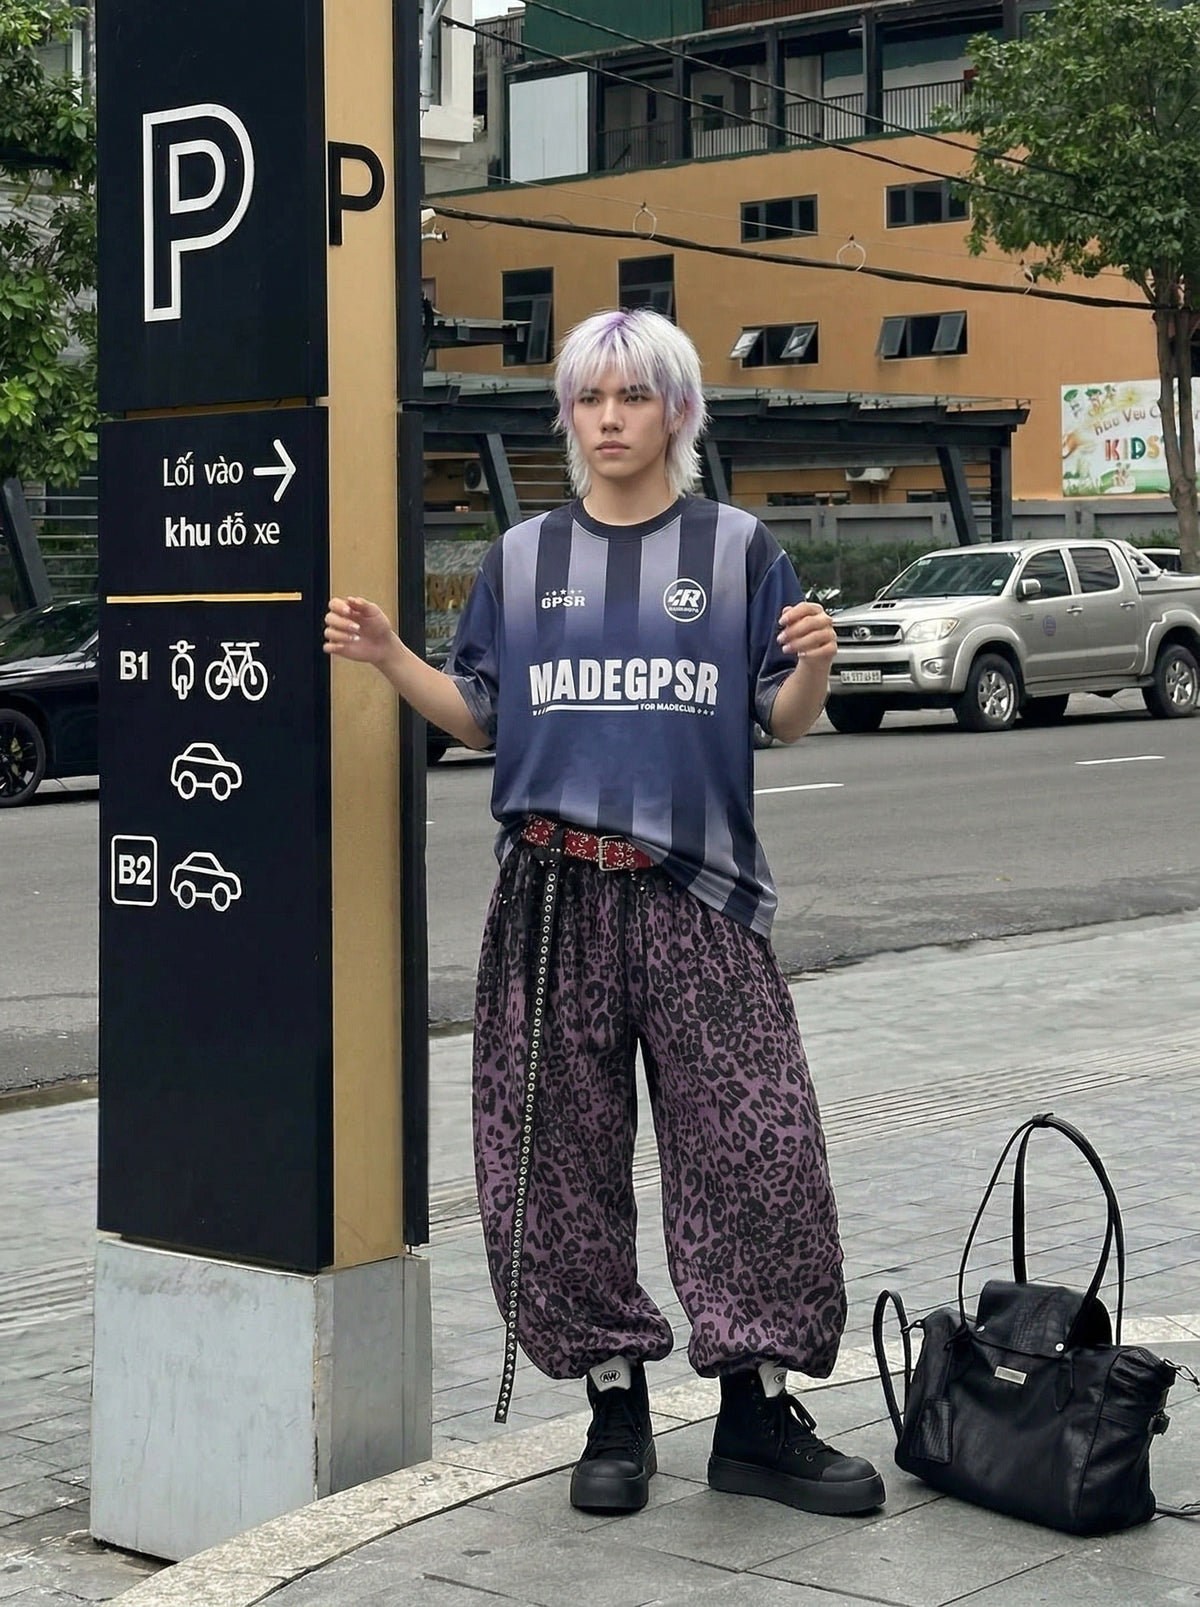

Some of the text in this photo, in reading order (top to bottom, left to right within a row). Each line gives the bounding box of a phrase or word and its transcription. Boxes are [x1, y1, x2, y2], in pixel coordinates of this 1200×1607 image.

[328, 141, 385, 246] P
[143, 104, 254, 322] P
[1105, 435, 1165, 461] KIDS
[163, 451, 244, 487] Lối vào
[165, 512, 280, 548] khu đỗ xe
[541, 595, 586, 609] GPSR
[119, 650, 149, 681] B1
[529, 657, 719, 706] MADEGPSR
[640, 703, 655, 711] FOR
[118, 854, 152, 886] B2
